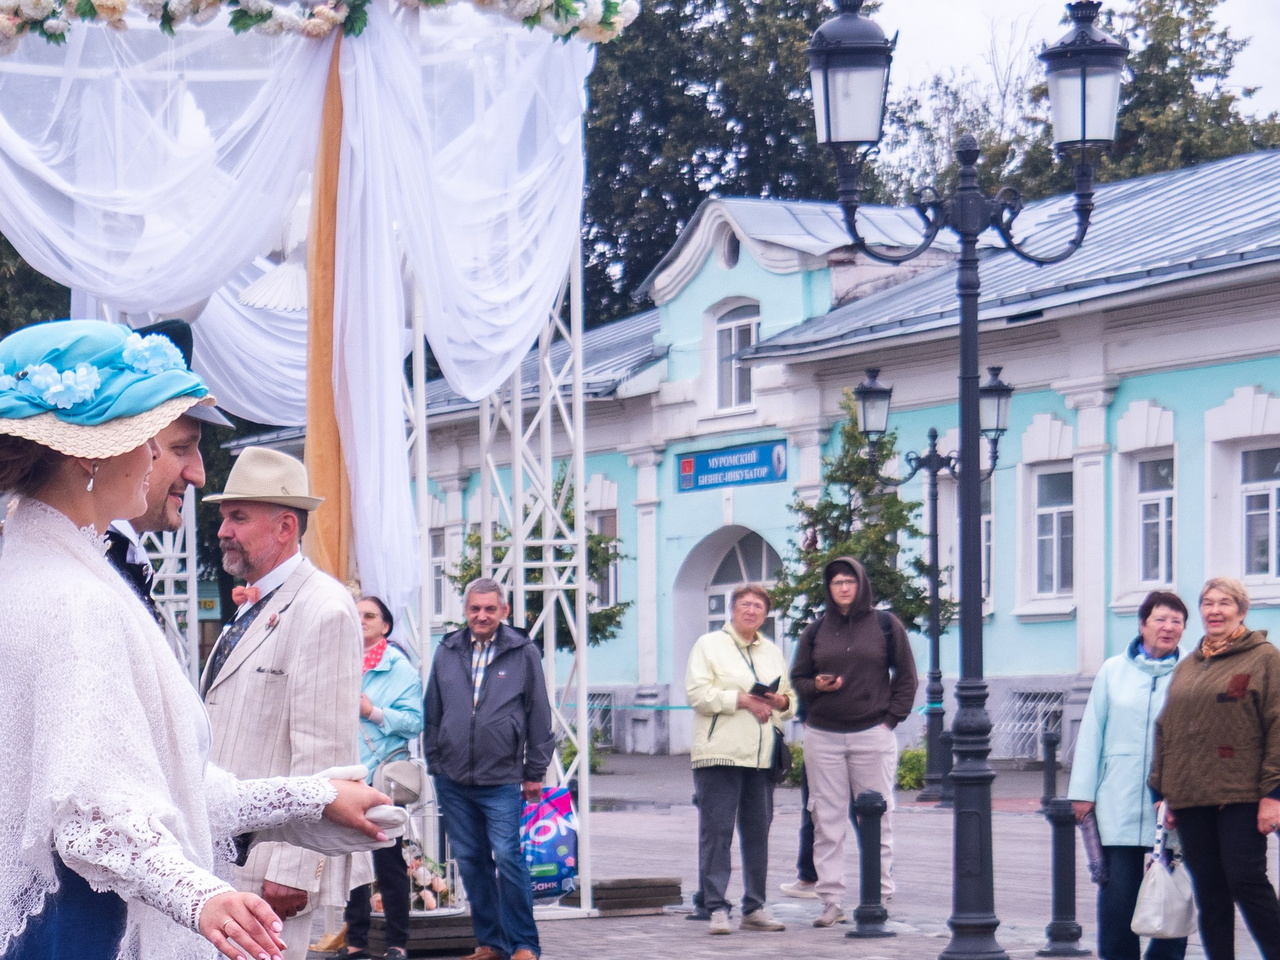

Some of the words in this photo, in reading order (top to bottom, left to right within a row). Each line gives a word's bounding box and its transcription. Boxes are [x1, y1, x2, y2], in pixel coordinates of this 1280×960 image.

[708, 450, 757, 469] МУРОМСКИЙ
[698, 467, 768, 486] БИЗНЕС-ИНКУБАТОР
[520, 815, 578, 846] ON
